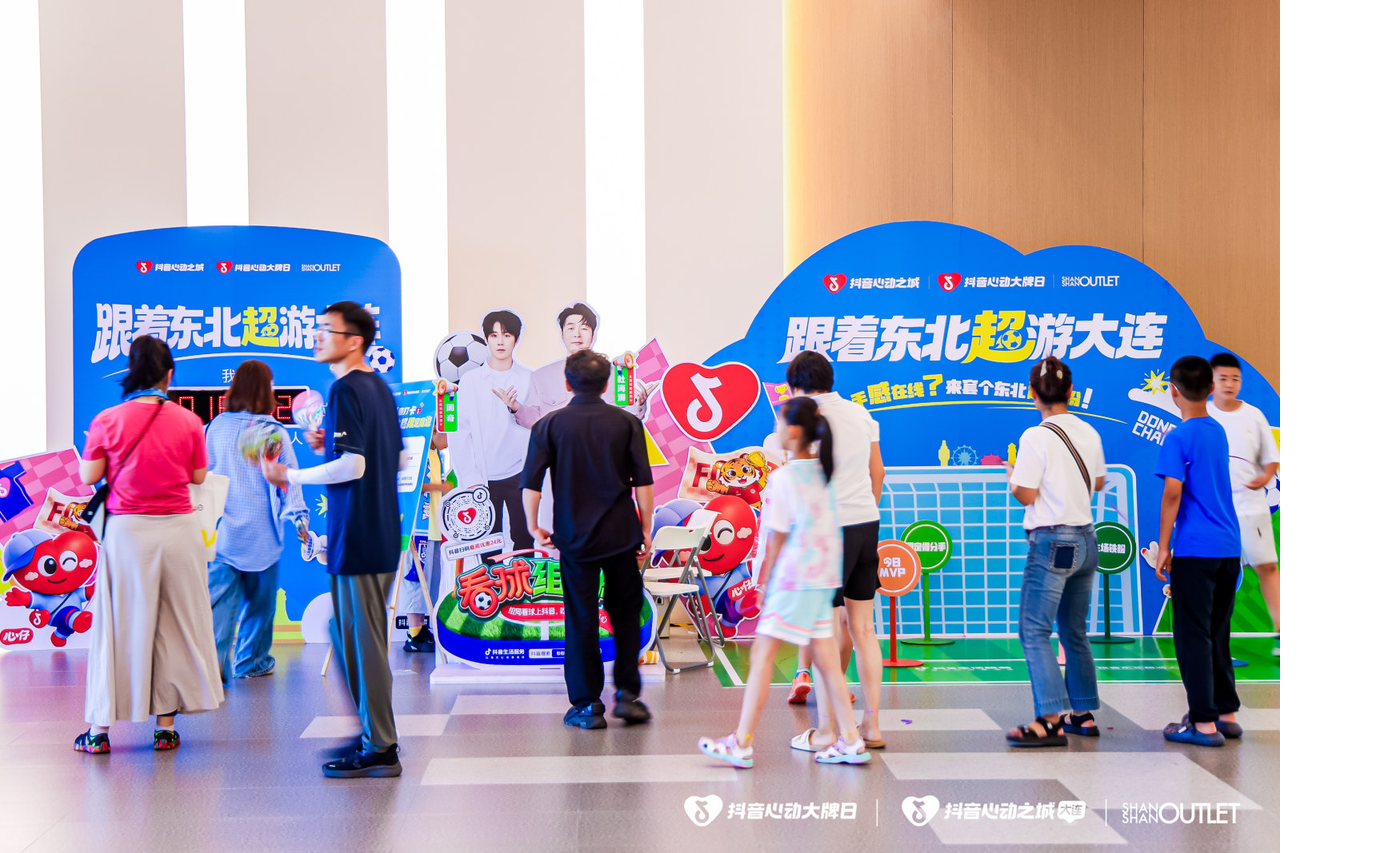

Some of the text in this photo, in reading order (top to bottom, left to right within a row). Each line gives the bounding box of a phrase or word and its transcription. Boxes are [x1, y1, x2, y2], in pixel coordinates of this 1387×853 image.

[155, 263, 204, 272] 抖音心动之城
[234, 263, 291, 272] 抖音心动大牌日
[849, 277, 920, 290] 抖音心动之城
[963, 276, 1046, 289] 抖音心动大牌日
[1079, 275, 1120, 287] OUTLET
[91, 303, 381, 363] 跟着东北超游
[777, 310, 1168, 364] 跟着东北超游大连
[882, 557, 901, 568] 今日
[879, 568, 906, 578] MVP
[3, 629, 31, 642] 心仔
